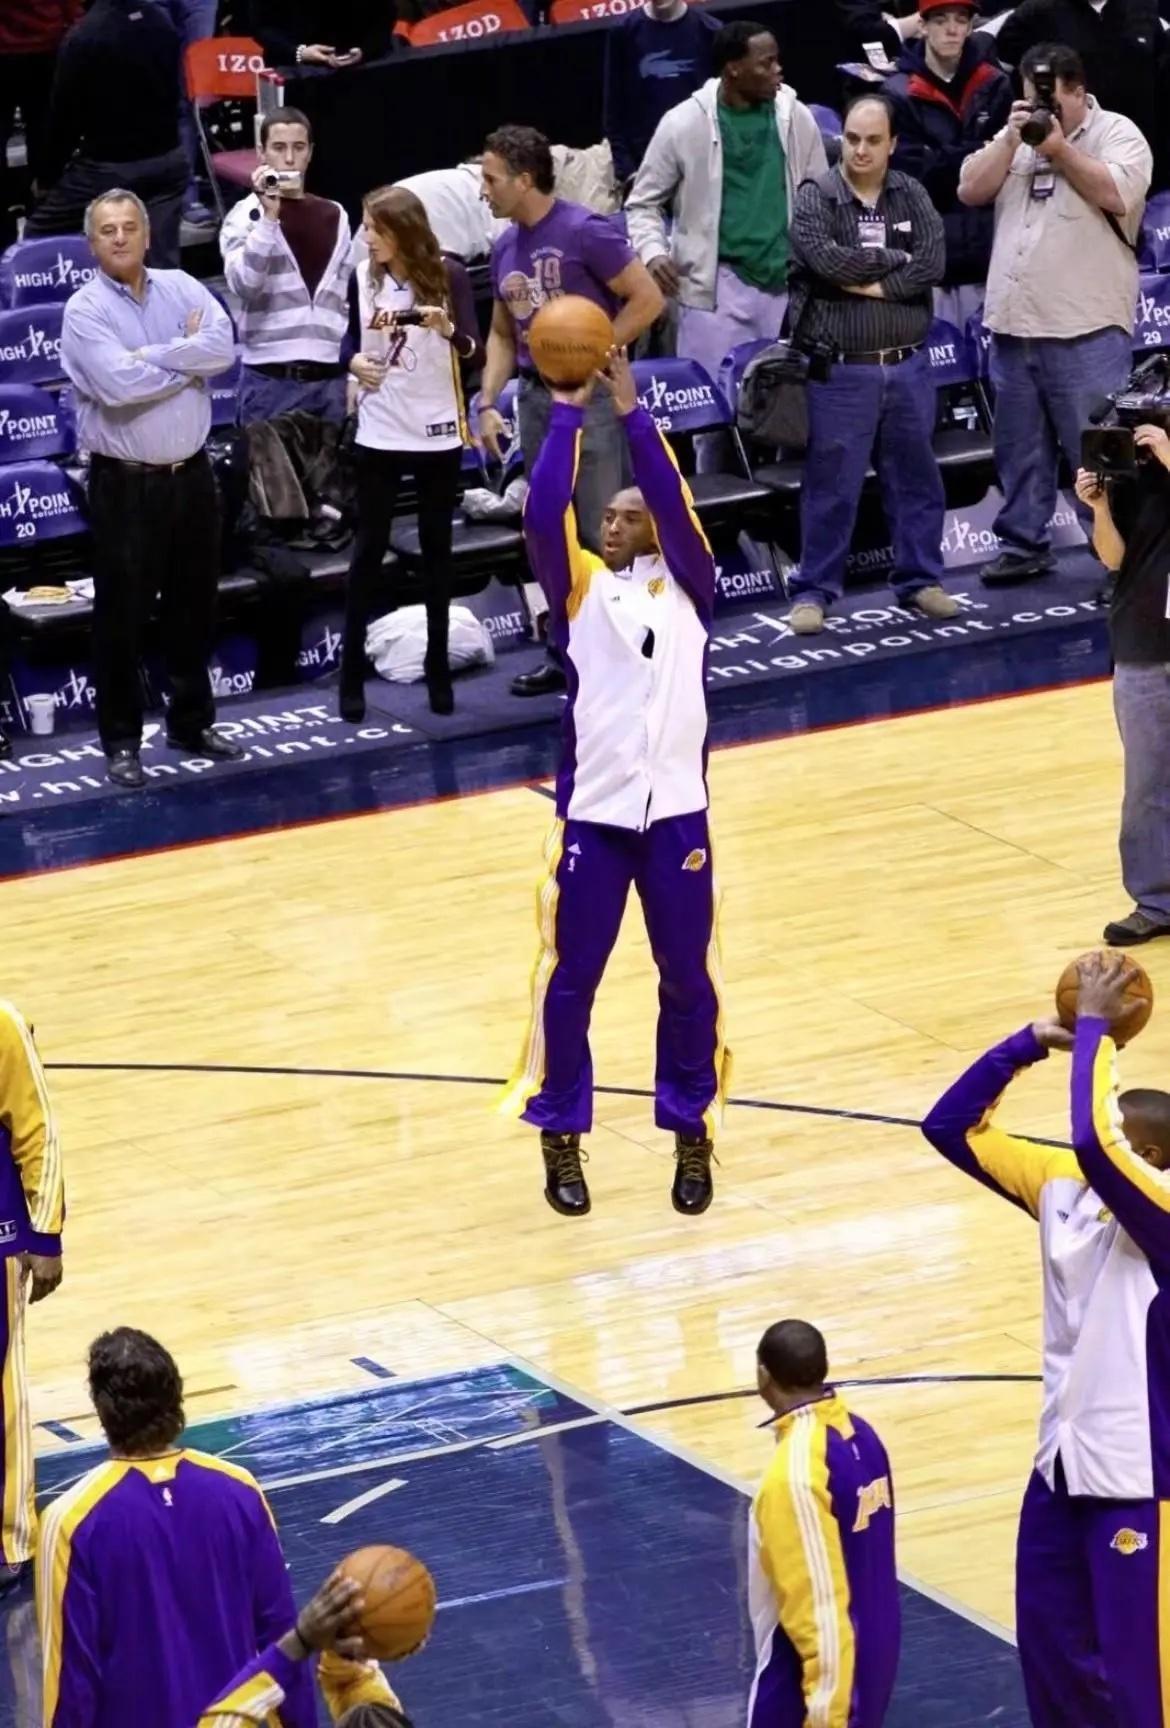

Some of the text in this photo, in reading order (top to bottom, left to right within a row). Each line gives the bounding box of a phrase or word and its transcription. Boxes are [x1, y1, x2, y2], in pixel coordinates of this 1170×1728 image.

[437, 13, 501, 43] IZOD
[217, 54, 265, 73] IZO
[14, 271, 53, 288] HIGH
[0, 345, 27, 361] IGH
[928, 344, 955, 361] INT
[664, 385, 712, 406] POINT
[668, 398, 715, 412] solutions
[7, 414, 56, 434] POINT
[29, 491, 70, 513] POIN
[16, 522, 36, 538] 20
[720, 570, 772, 592] POINT
[725, 584, 775, 599] solutions
[482, 611, 522, 632] OINT
[0, 695, 329, 774] IGH OINT
